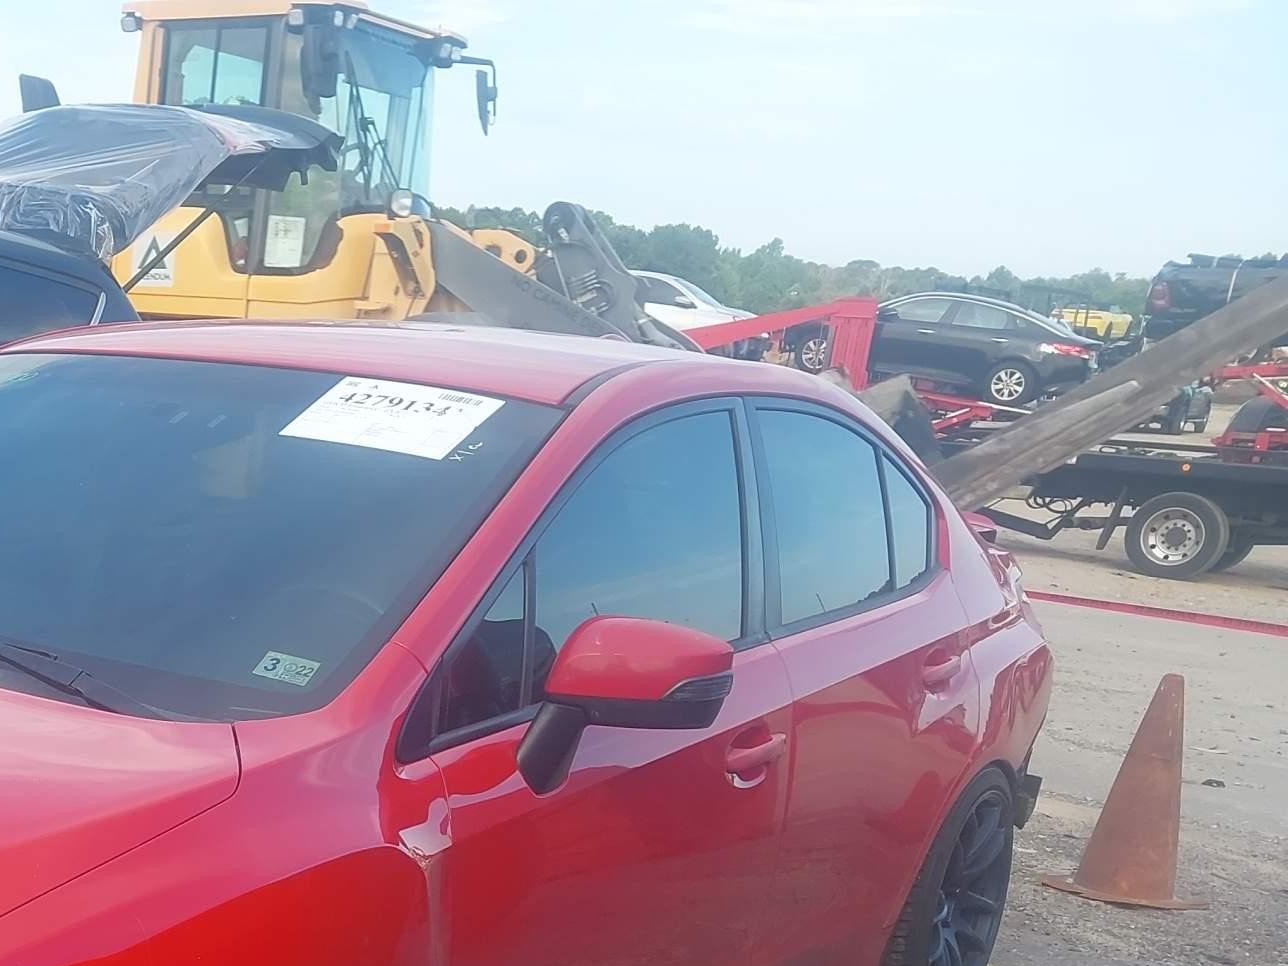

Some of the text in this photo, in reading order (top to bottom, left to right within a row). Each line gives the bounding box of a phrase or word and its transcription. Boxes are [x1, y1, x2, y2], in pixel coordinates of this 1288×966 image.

[339, 392, 463, 417] 4279134
[263, 657, 281, 672] 3
[295, 664, 314, 678] 22
